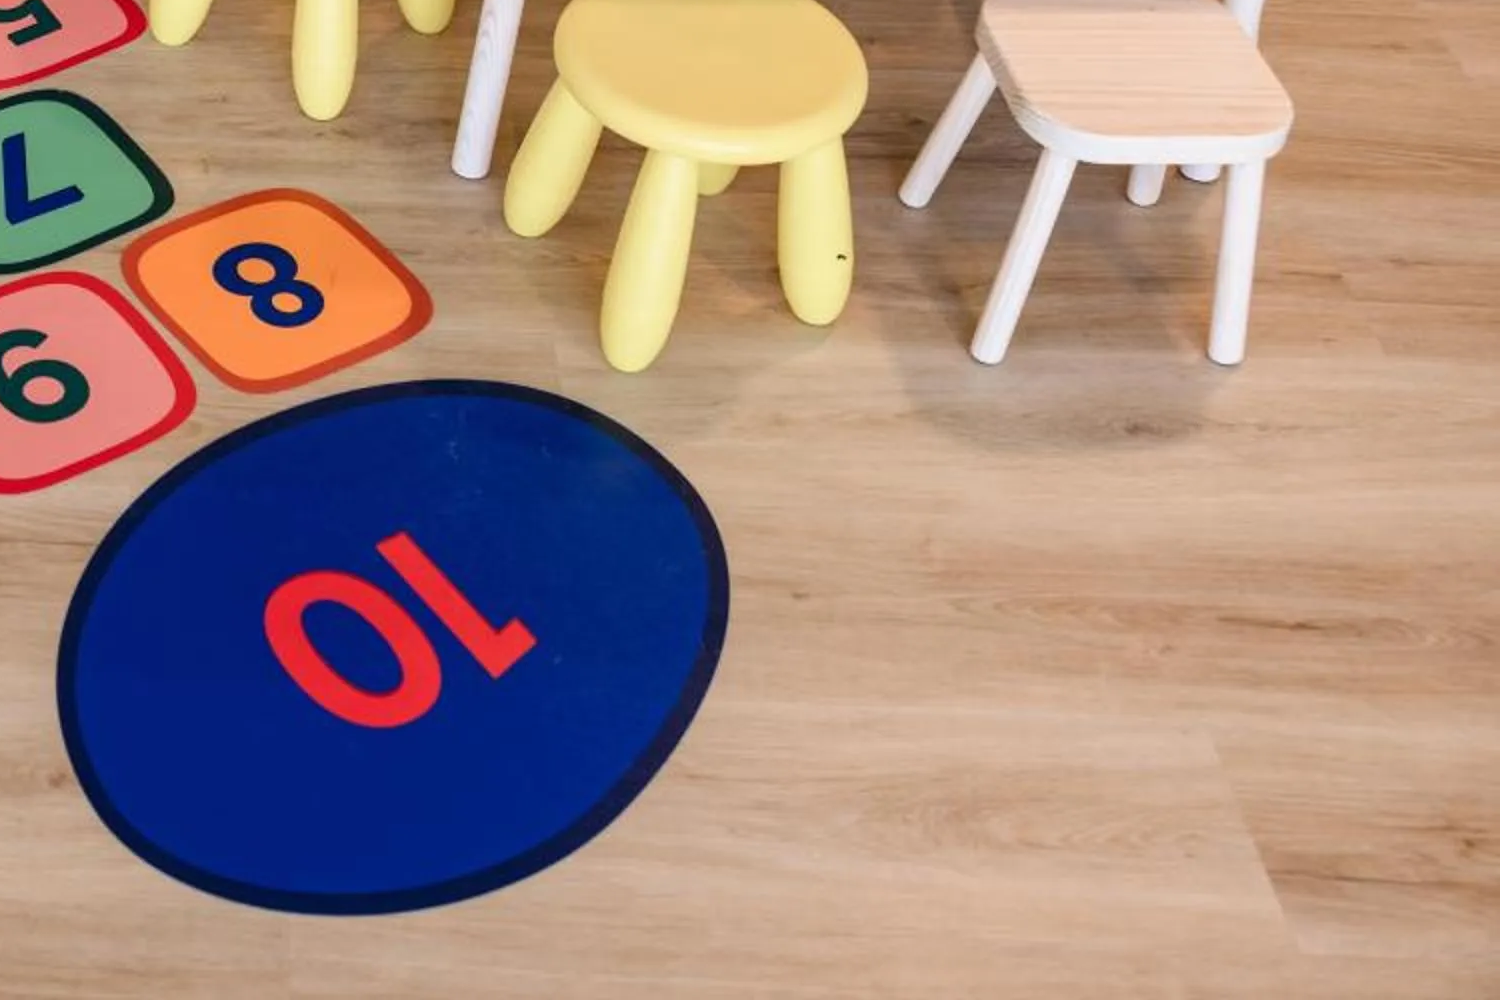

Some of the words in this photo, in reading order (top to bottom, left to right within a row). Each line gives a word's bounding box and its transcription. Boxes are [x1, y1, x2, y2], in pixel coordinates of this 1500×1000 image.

[1, 132, 85, 226] 7
[212, 242, 325, 328] 8
[264, 532, 536, 728] 10
